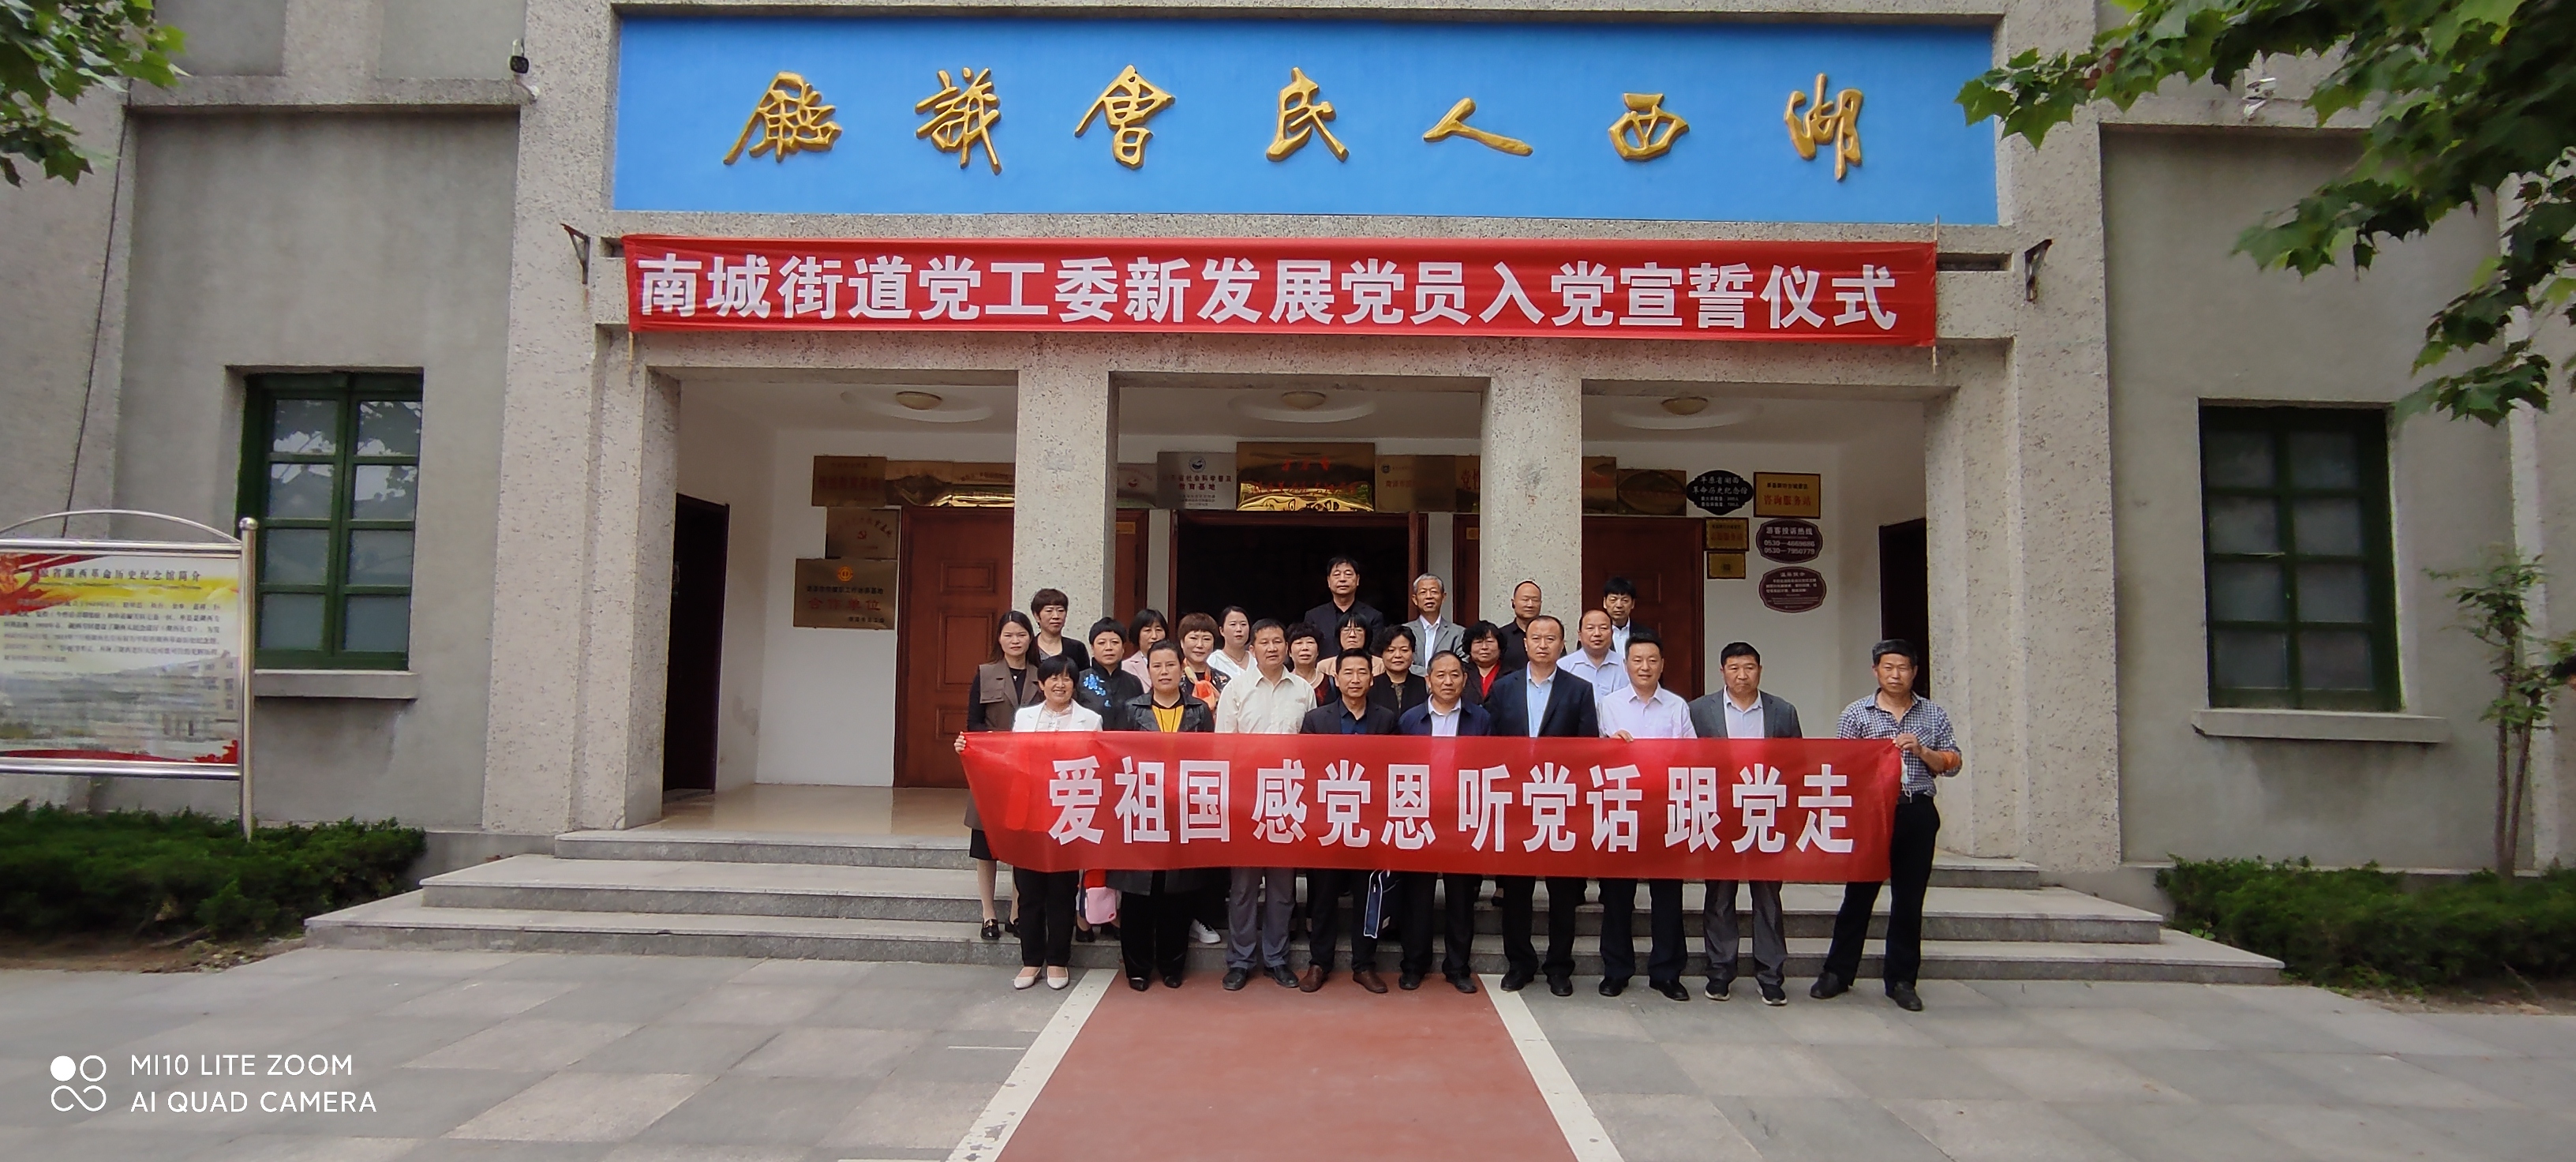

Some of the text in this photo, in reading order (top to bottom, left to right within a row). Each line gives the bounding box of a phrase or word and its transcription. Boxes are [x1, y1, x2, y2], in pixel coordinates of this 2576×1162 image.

[638, 253, 1897, 330] 南城街道党工委新发展党员入党宣誓仪式
[1693, 485, 1748, 494] 革命历史纪念馆
[1764, 495, 1811, 506] 咨询服务站
[1765, 526, 1813, 535] 游客投诉热线
[809, 597, 882, 611] 合作单位
[1049, 756, 1854, 853] 爱祖国 感党恩 听党话 跟党走
